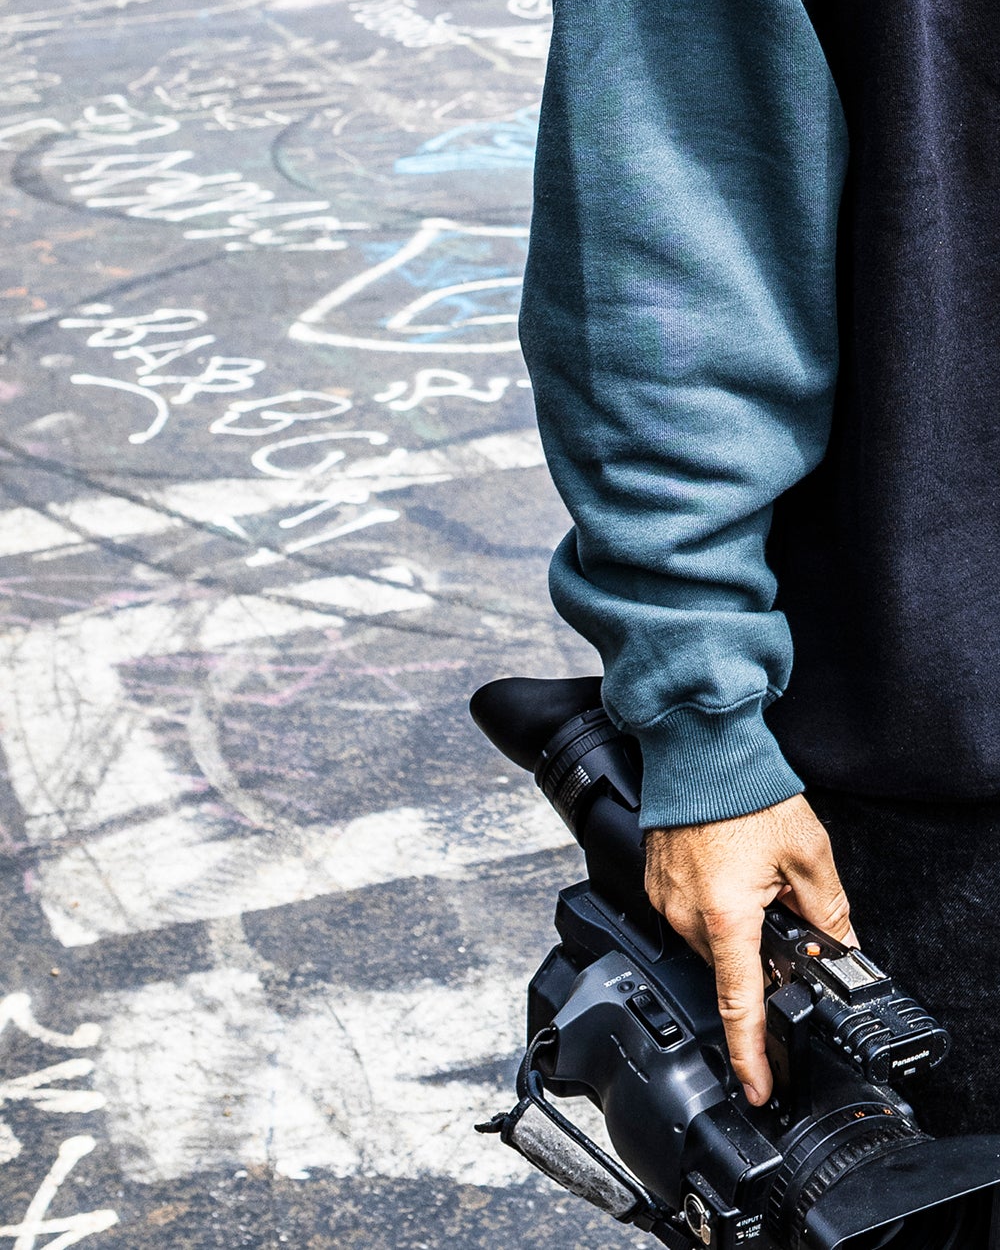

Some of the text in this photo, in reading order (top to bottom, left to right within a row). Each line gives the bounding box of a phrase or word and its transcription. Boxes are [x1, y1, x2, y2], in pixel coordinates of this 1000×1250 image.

[892, 1050, 930, 1068] Panasonic
[741, 1215, 760, 1226] INPUT
[748, 1231, 760, 1239] MIC
